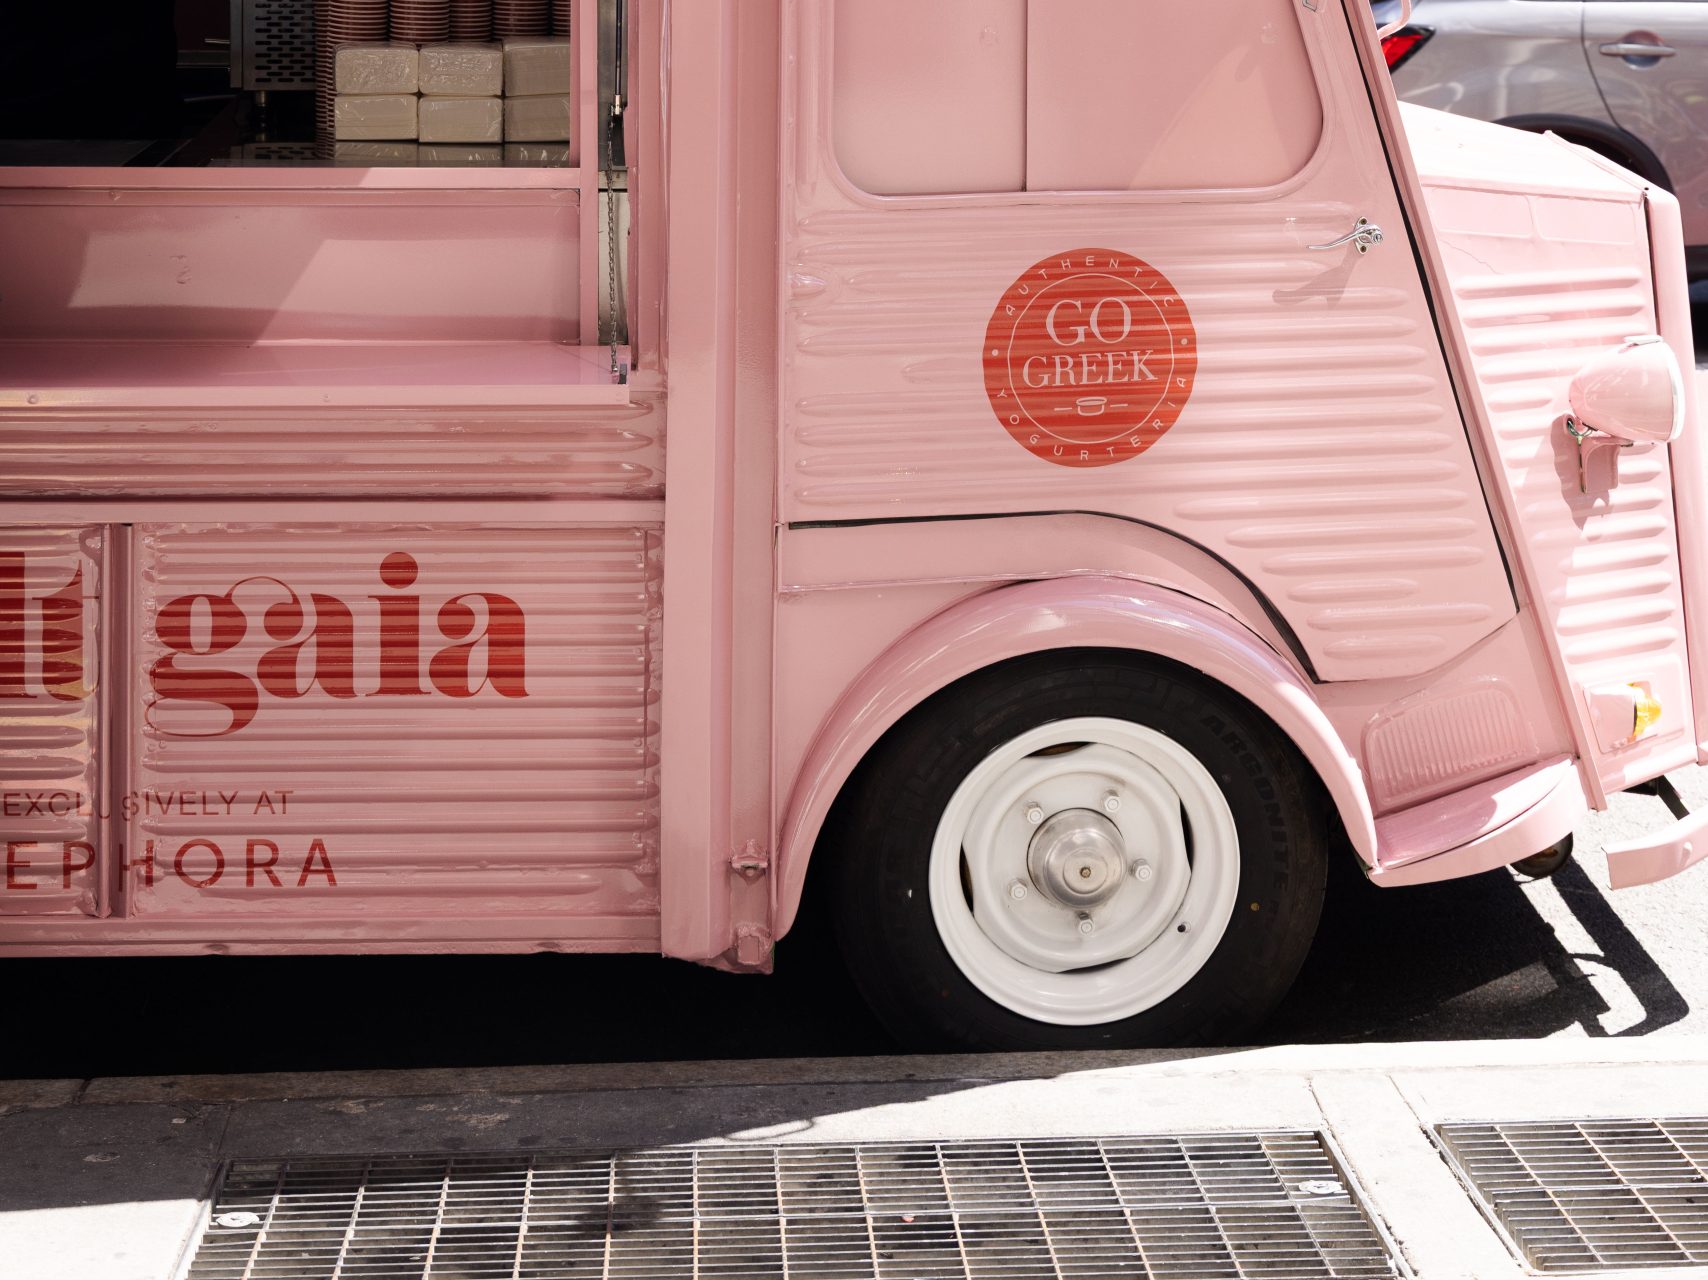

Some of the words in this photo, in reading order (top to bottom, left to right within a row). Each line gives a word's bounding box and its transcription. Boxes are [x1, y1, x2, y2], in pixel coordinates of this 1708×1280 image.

[1005, 255, 1175, 315] AUTHENTIC
[1045, 297, 1132, 346] GO
[1022, 349, 1159, 389] GREEK
[996, 376, 1187, 461] YOGURTERIA
[143, 552, 531, 737] gaia
[253, 790, 295, 816] AT
